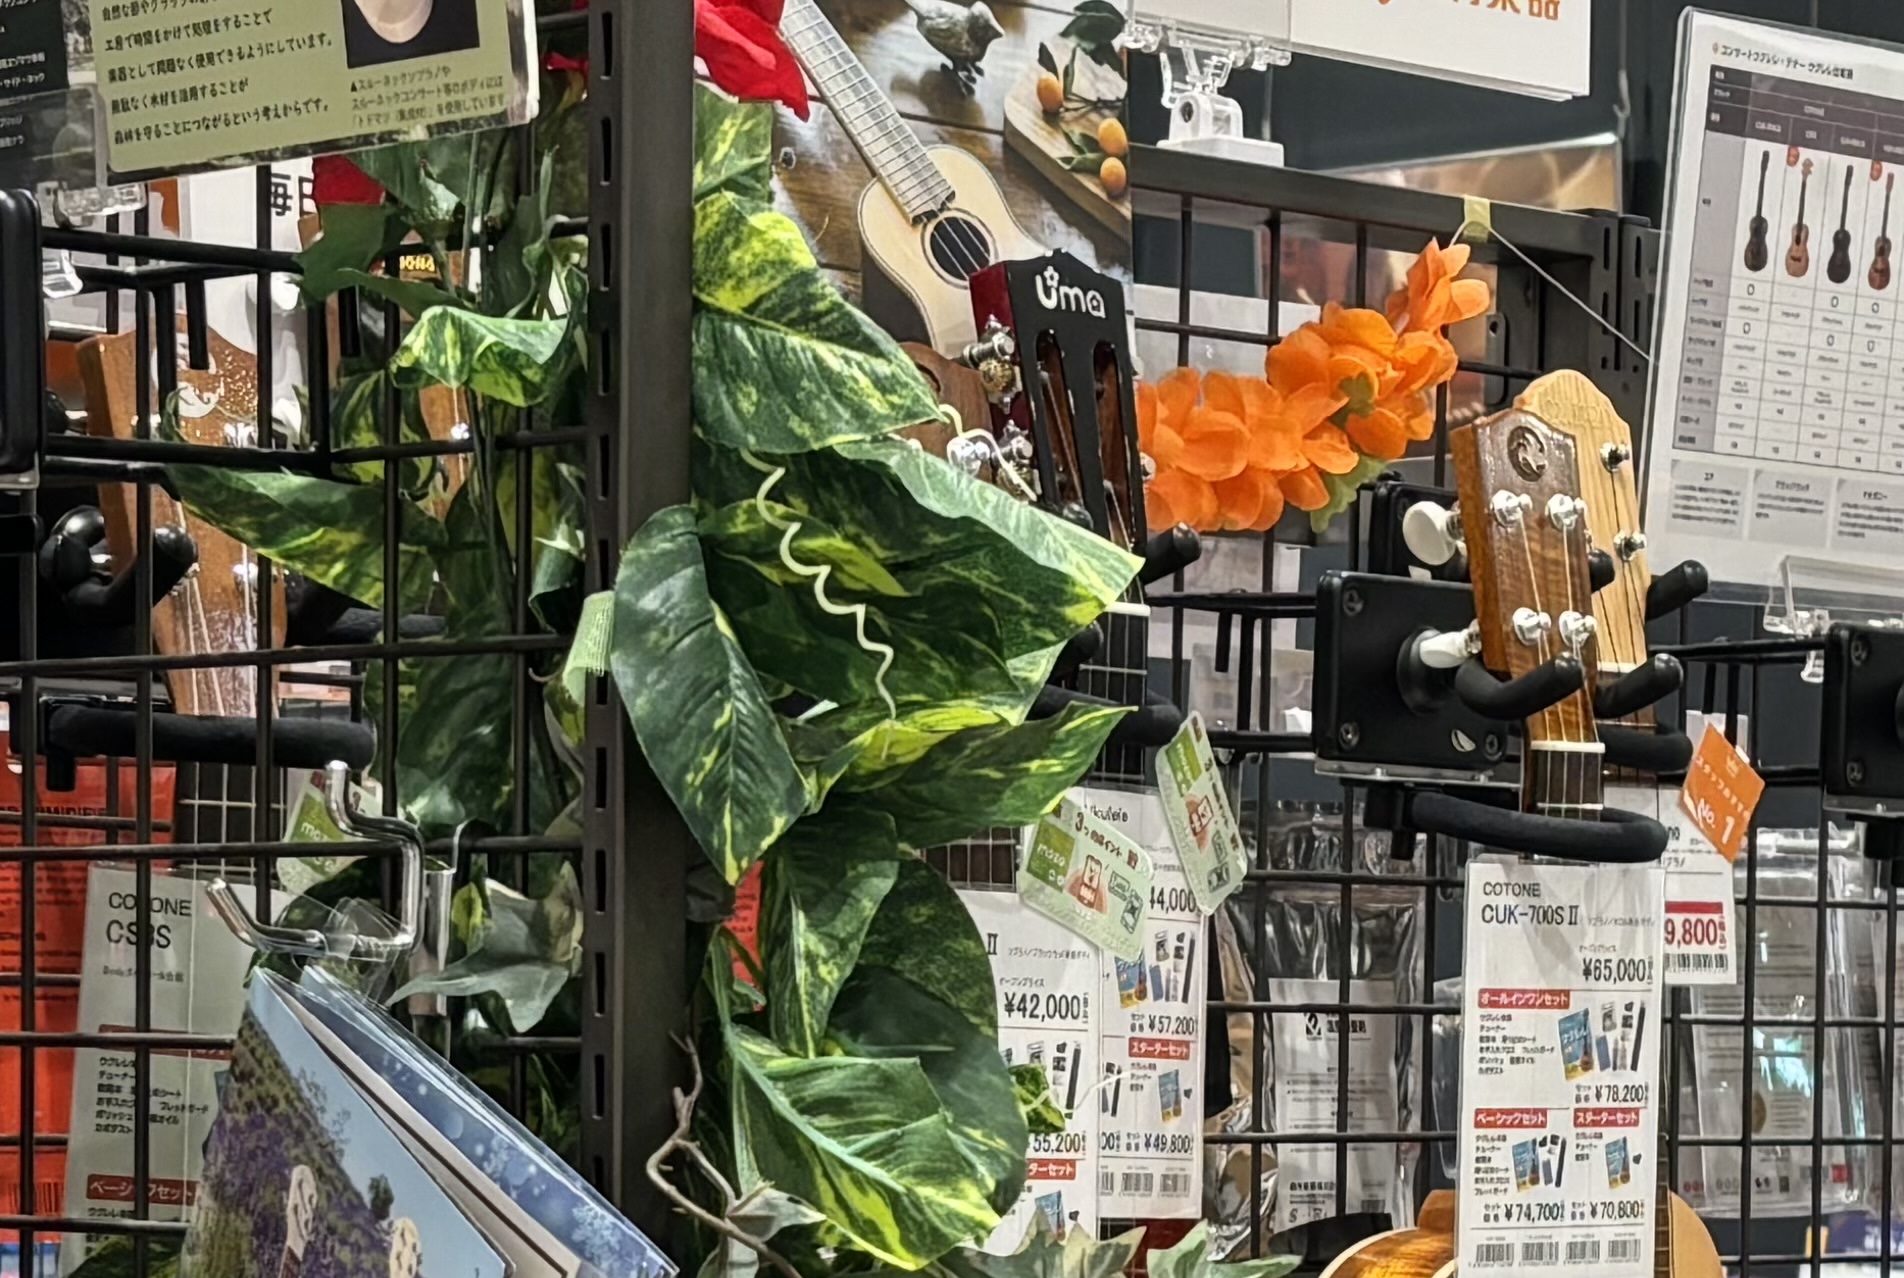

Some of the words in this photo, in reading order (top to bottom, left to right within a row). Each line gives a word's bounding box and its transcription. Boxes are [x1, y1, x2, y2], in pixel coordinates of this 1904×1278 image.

[1035, 266, 1106, 319] Uma
[1697, 798, 1717, 829] No.
[1721, 816, 1735, 844] 1
[1483, 882, 1542, 897] COTONE
[108, 892, 193, 917] COONE
[1581, 958, 1647, 983] ¥65,000
[1003, 991, 1081, 1022] ¥42,000
[1481, 991, 1568, 1007] オールインワンセット
[1149, 1016, 1195, 1034] ¥57,200
[1130, 1041, 1188, 1057] スターターセット
[1595, 1083, 1645, 1103] ¥78,200
[1476, 1111, 1547, 1125] ベーシックセット
[1575, 1111, 1638, 1124] スターターセット
[1504, 1203, 1561, 1222] ¥74,700
[1589, 1200, 1640, 1220] ¥70,800
